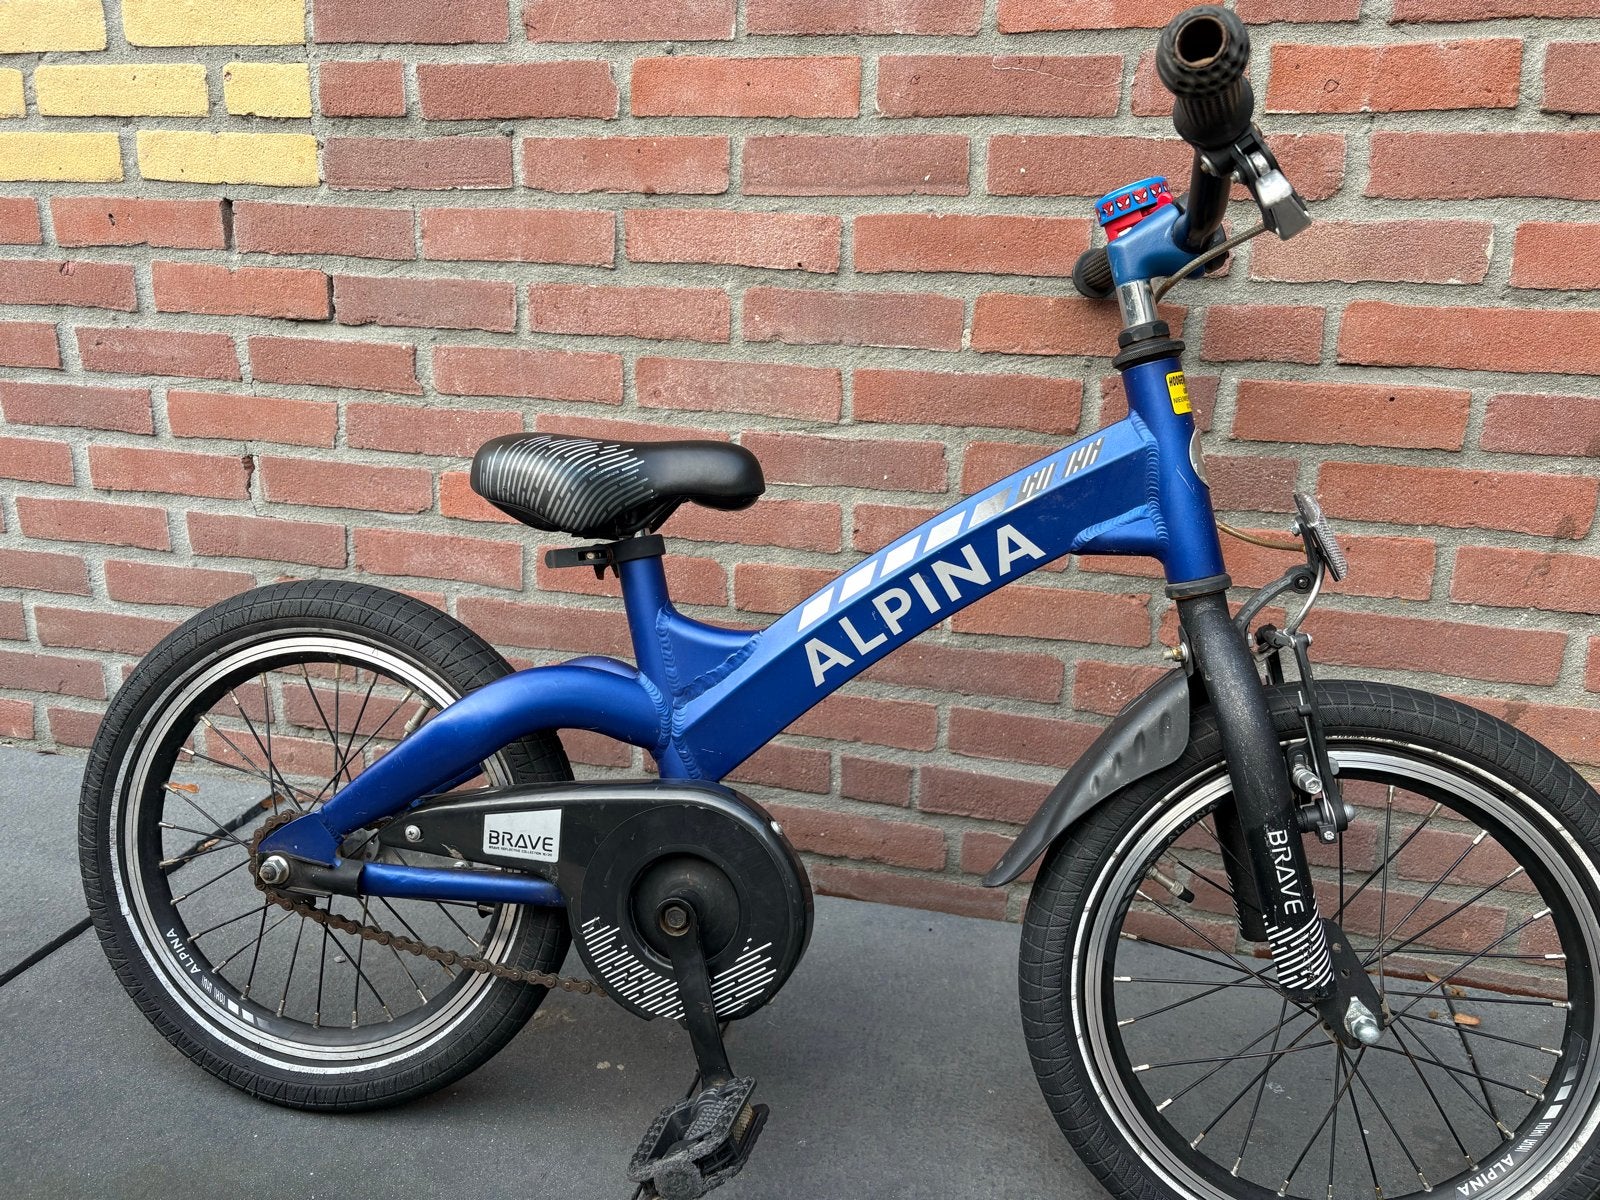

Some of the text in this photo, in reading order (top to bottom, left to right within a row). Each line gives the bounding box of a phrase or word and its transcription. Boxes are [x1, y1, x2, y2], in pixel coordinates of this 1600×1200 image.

[804, 524, 1047, 688] ALPINA
[488, 829, 554, 853] BRAVE
[1168, 804, 1218, 844] ALPINA
[1267, 829, 1305, 915] BRAVE
[166, 927, 202, 974] ALPINA
[1456, 1153, 1515, 1196] ALPINA
